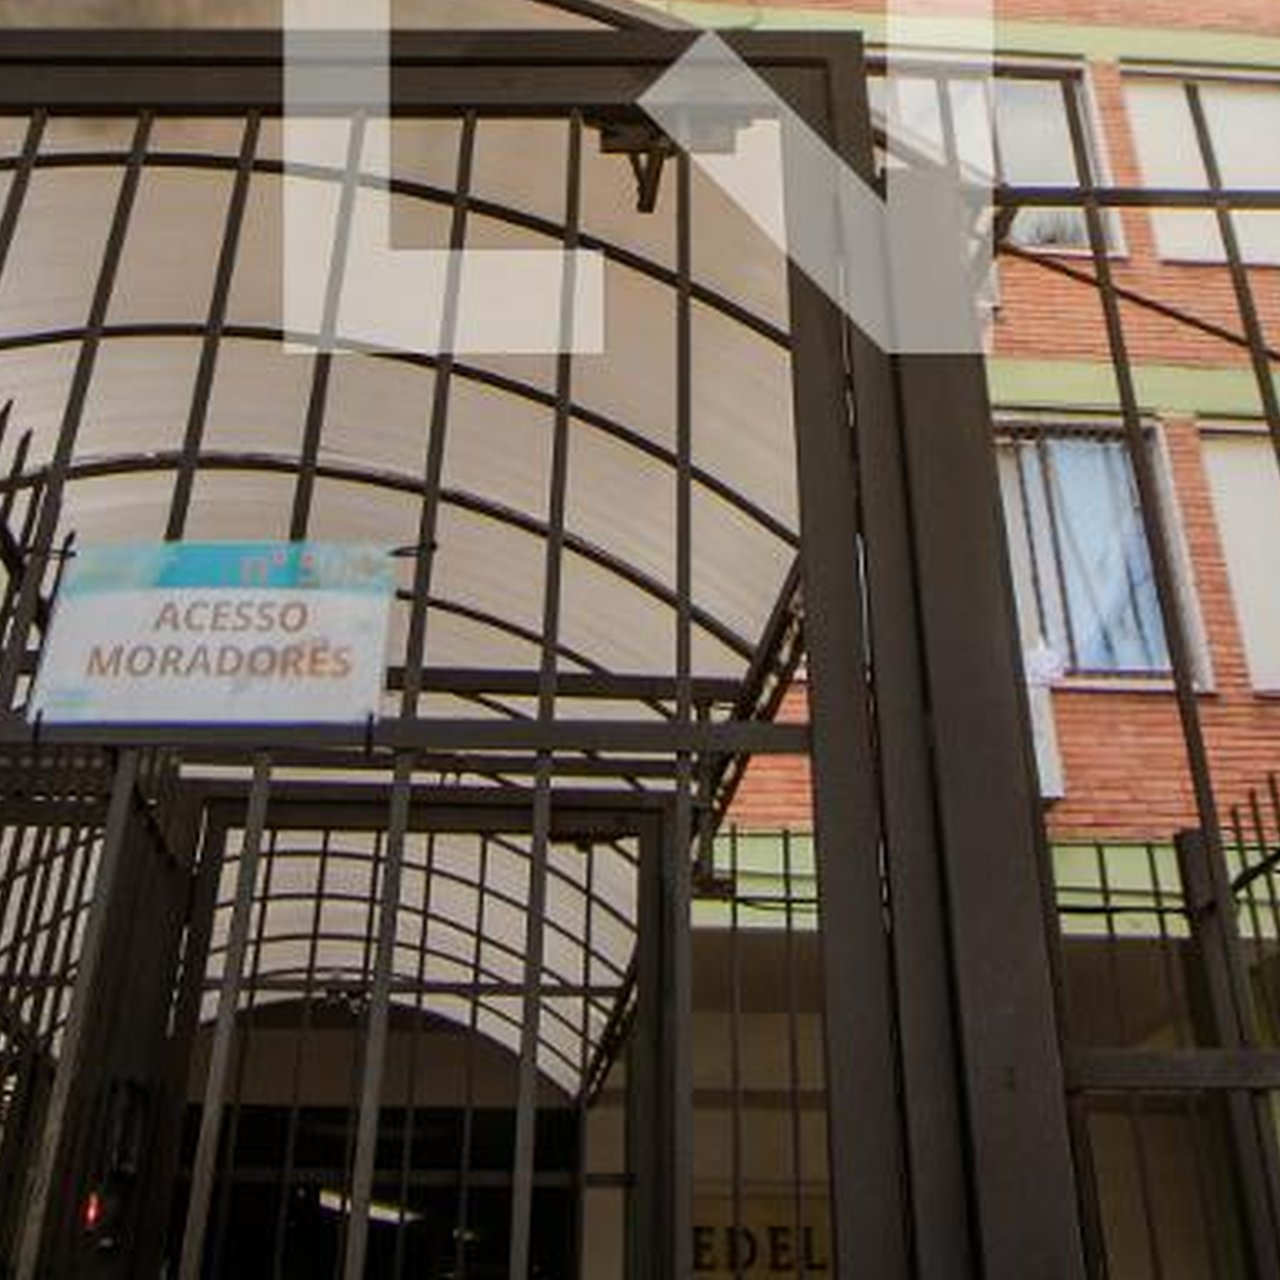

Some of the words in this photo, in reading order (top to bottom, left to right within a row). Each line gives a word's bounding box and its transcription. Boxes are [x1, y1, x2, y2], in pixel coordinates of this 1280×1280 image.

[154, 601, 308, 633] ACESSO
[87, 642, 353, 679] MORADORES
[692, 1226, 827, 1270] EDEL
